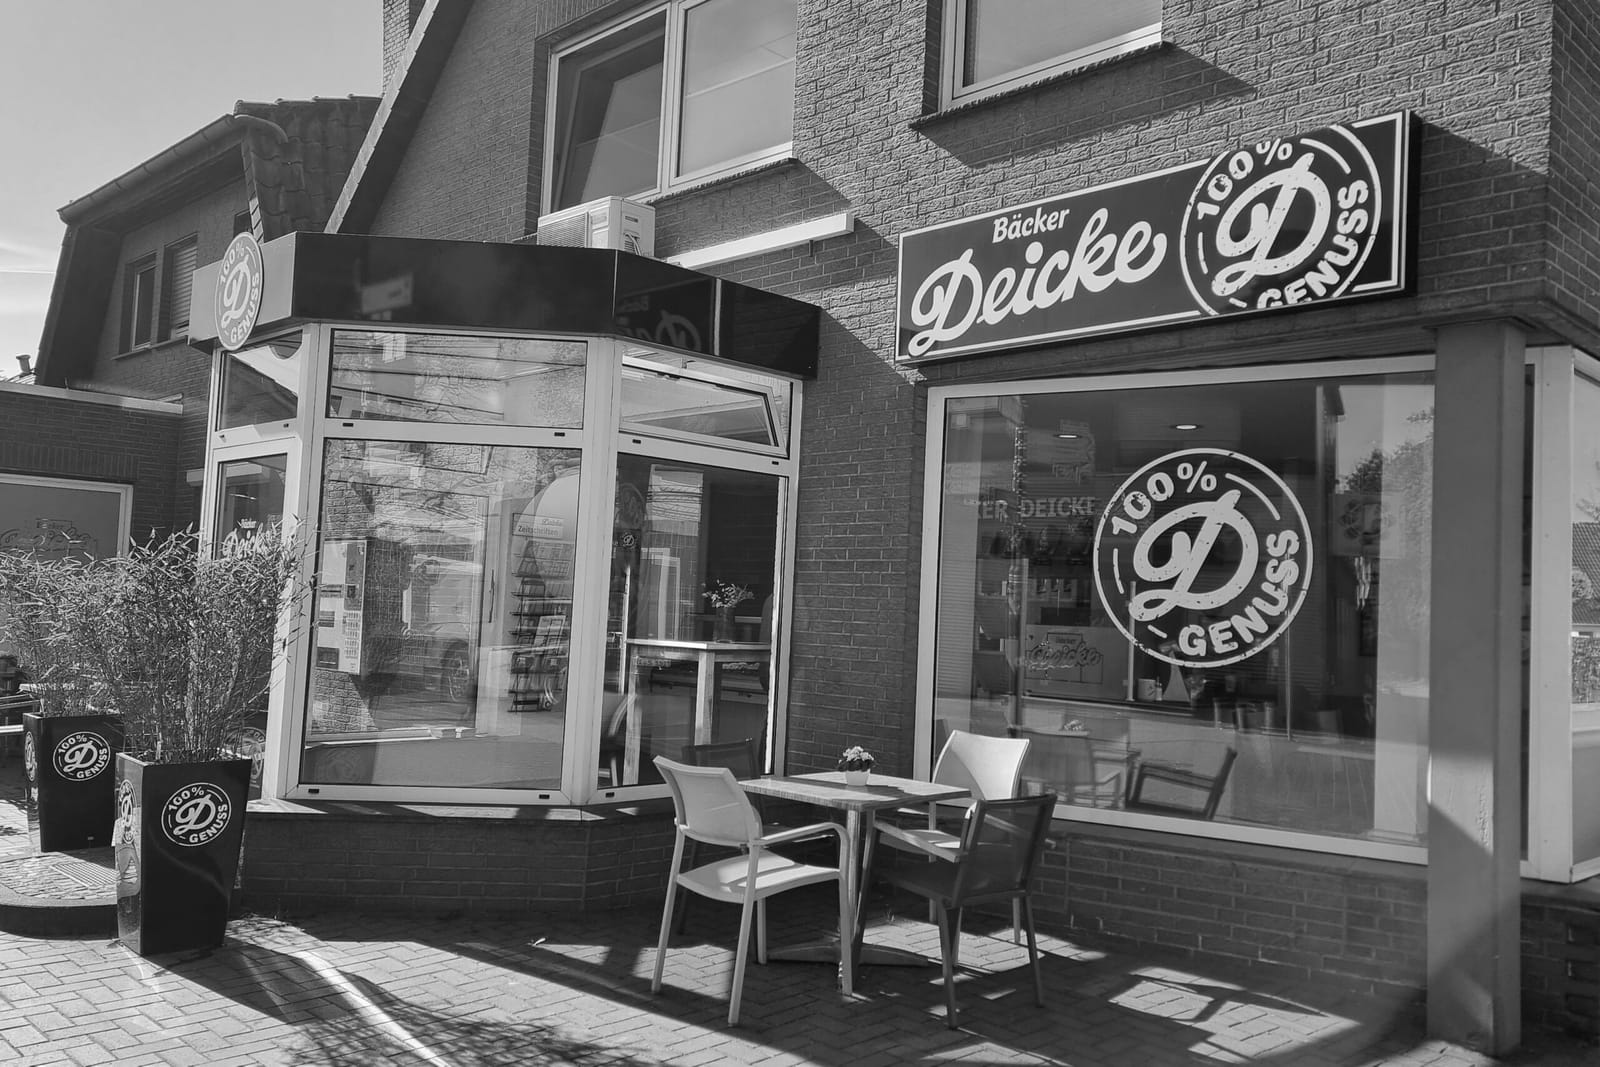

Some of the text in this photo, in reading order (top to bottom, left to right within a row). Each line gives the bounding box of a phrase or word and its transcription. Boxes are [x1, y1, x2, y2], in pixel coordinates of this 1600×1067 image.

[1197, 138, 1293, 220] 100%
[992, 207, 1070, 243] Bäcker
[1257, 180, 1369, 309] GENUSS
[908, 208, 1167, 356] Deicke
[1112, 461, 1217, 536] 100%
[1178, 528, 1300, 657] GENUSS
[58, 734, 87, 753] 100%
[76, 748, 107, 778] GENUSS
[168, 786, 205, 811] 100%
[189, 804, 228, 843] GENUSS
